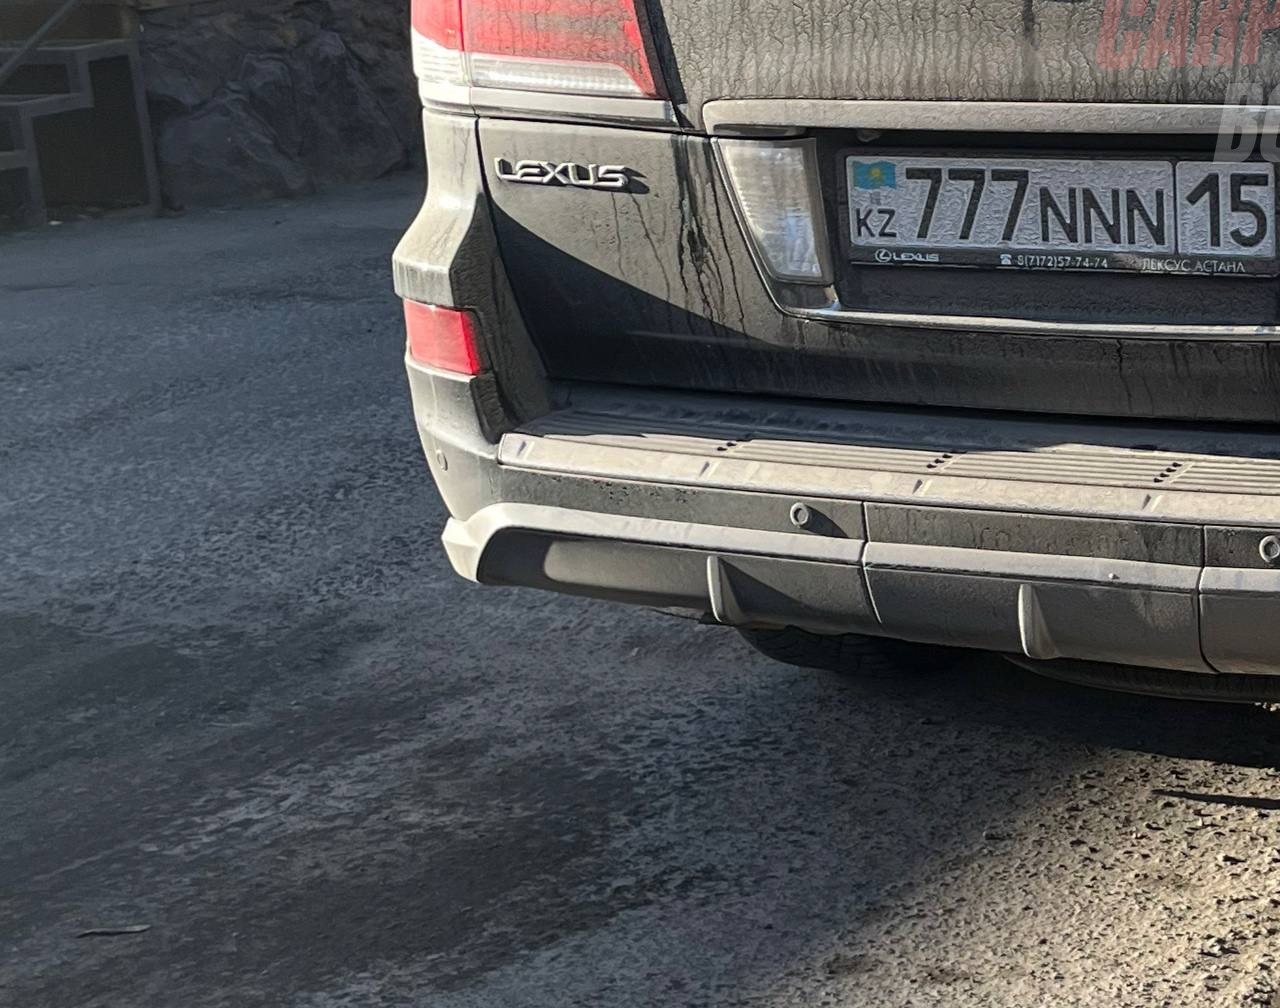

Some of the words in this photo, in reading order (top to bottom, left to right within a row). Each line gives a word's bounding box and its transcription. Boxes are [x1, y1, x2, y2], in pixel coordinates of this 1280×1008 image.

[494, 157, 628, 188] LEXUS
[855, 208, 897, 237] KZ
[892, 252, 940, 262] LEXUS
[1142, 257, 1192, 272] ЛЕКСУС
[1194, 259, 1246, 273] АСТАНА
